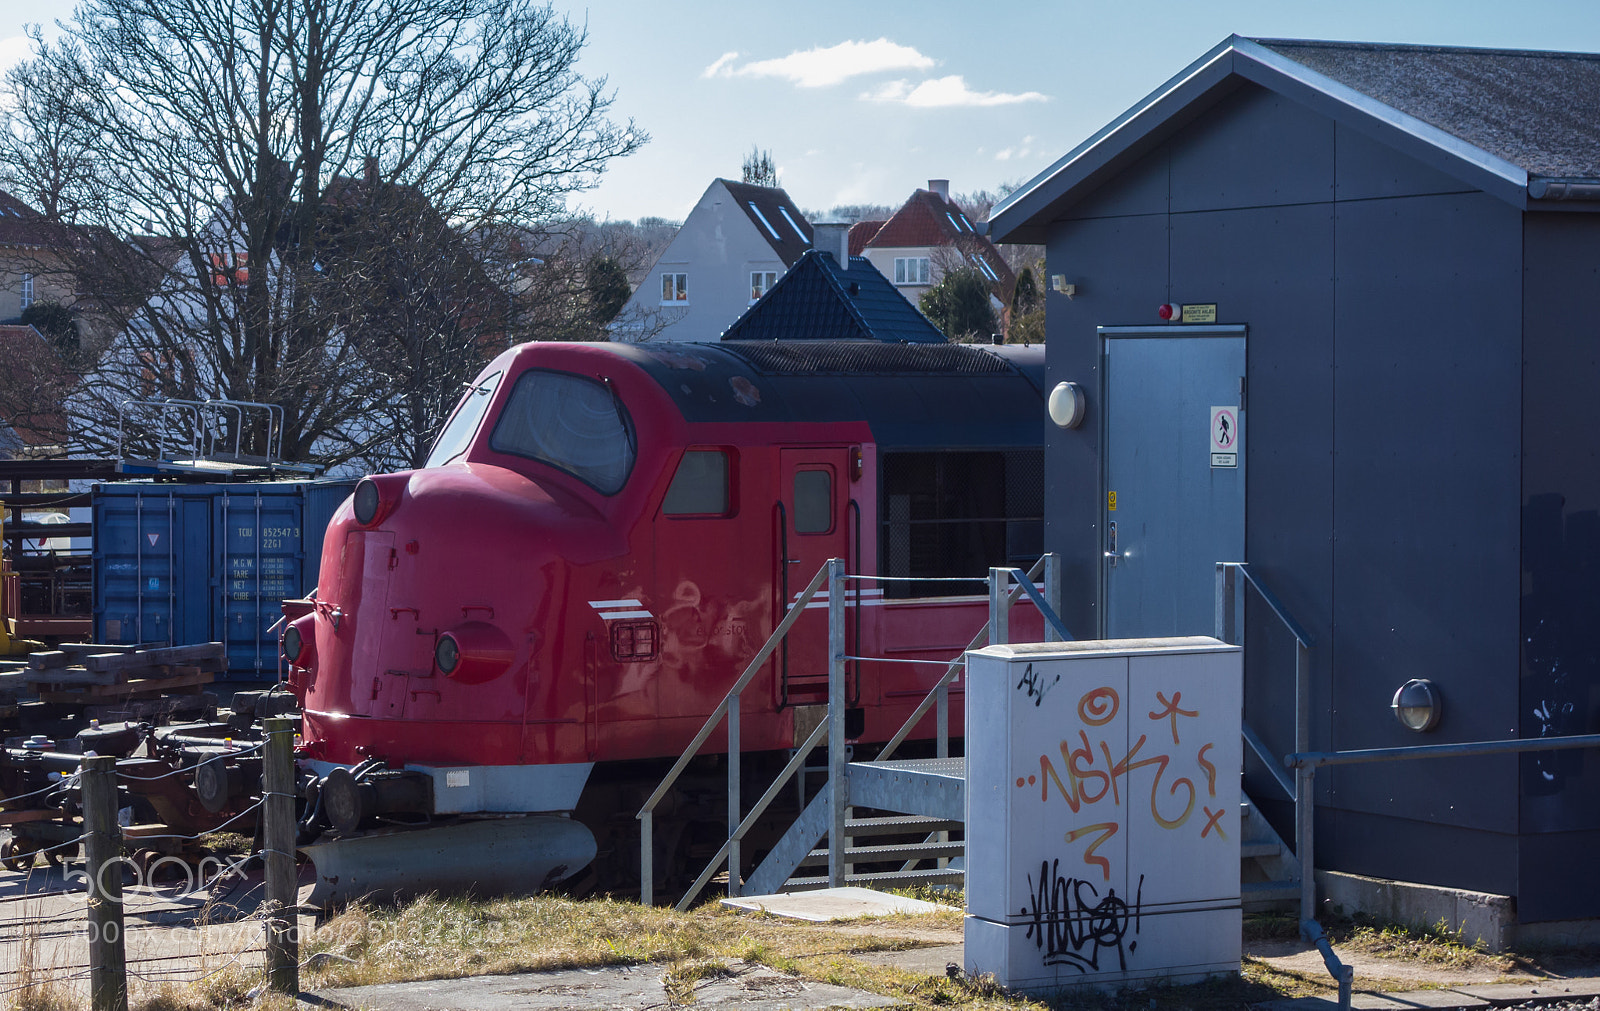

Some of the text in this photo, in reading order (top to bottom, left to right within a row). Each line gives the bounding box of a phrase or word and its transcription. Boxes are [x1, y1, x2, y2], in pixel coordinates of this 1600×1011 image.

[263, 528, 291, 537] 852547
[233, 570, 249, 578] TARE
[233, 581, 245, 589] NET
[233, 592, 249, 600] CUBE
